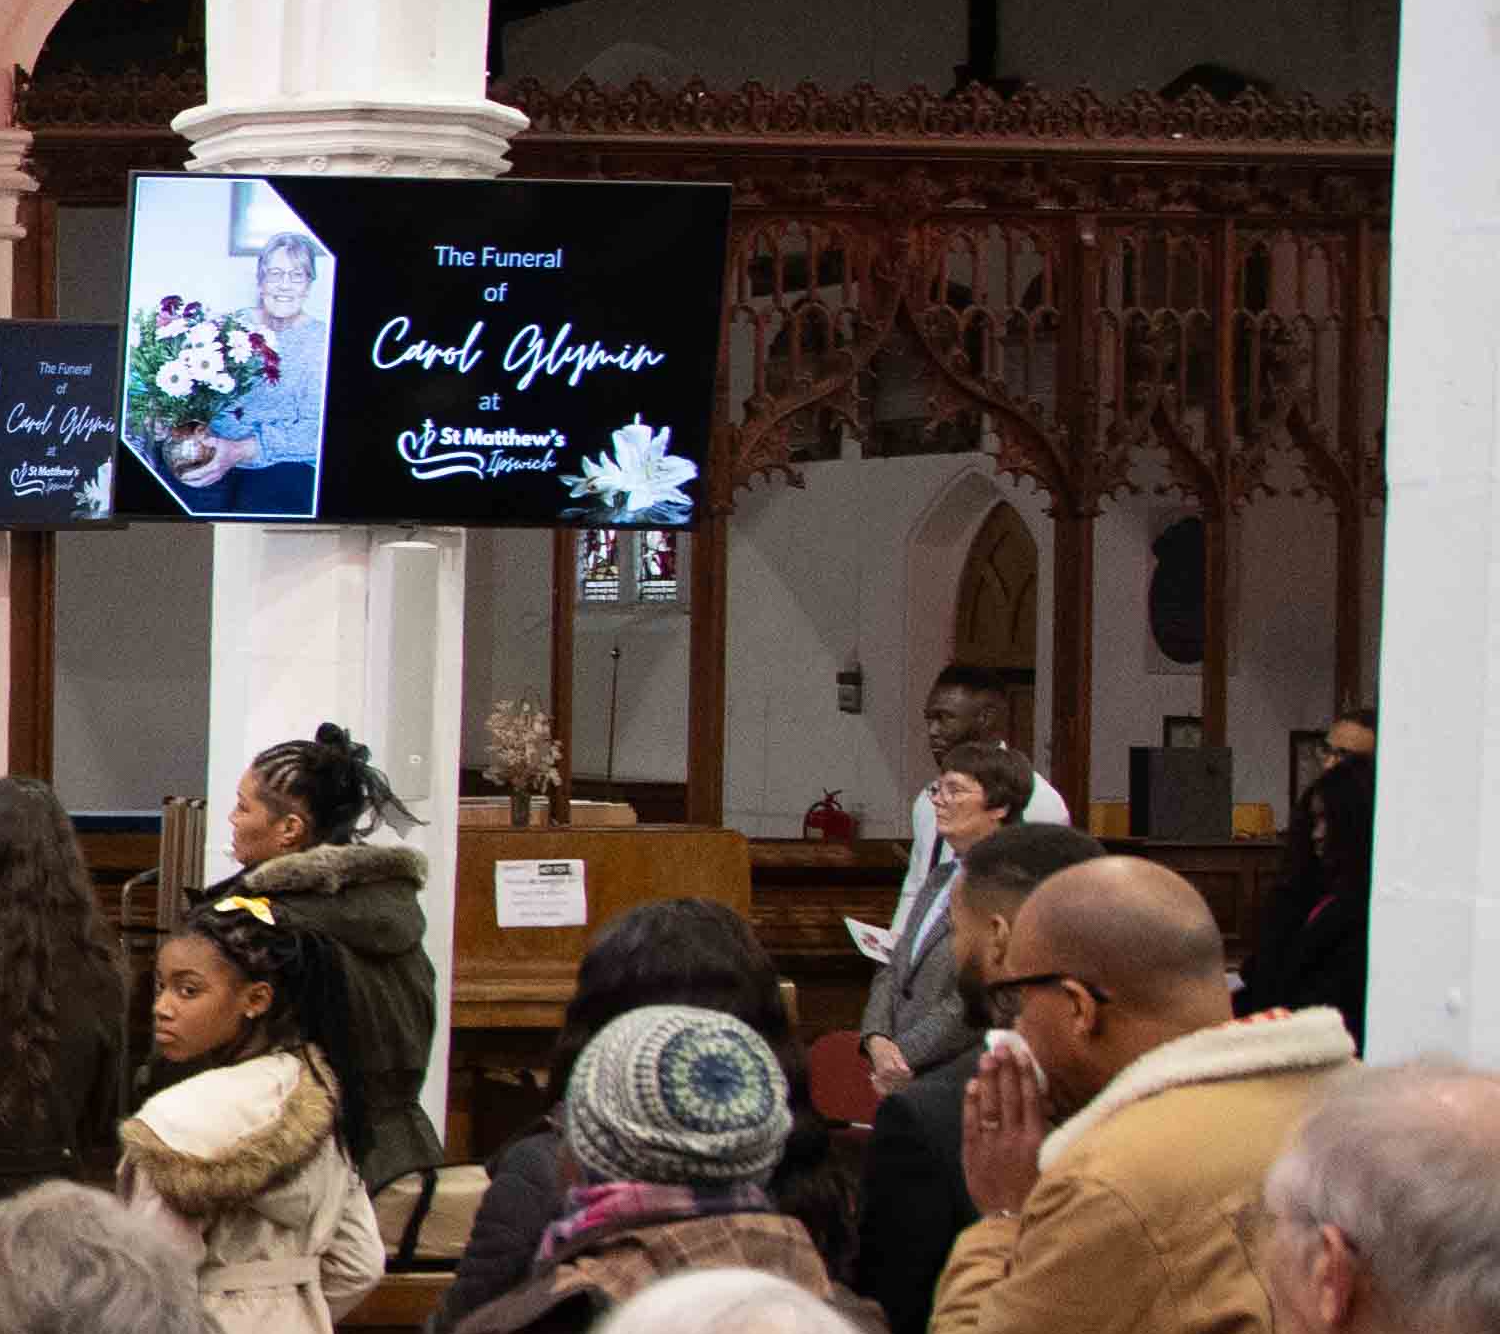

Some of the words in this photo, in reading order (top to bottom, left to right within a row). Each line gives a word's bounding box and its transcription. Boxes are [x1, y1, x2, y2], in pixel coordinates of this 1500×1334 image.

[433, 244, 476, 267] The
[481, 245, 563, 269] Funeral
[483, 282, 509, 302] of
[371, 315, 485, 374] Carol
[38, 362, 55, 375] The
[58, 362, 93, 377] Funeral
[55, 382, 68, 395] of
[477, 392, 502, 412] at
[6, 401, 53, 436] Carol
[438, 426, 462, 446] St
[464, 427, 568, 448] Matthew's
[484, 448, 558, 478] Ipswich
